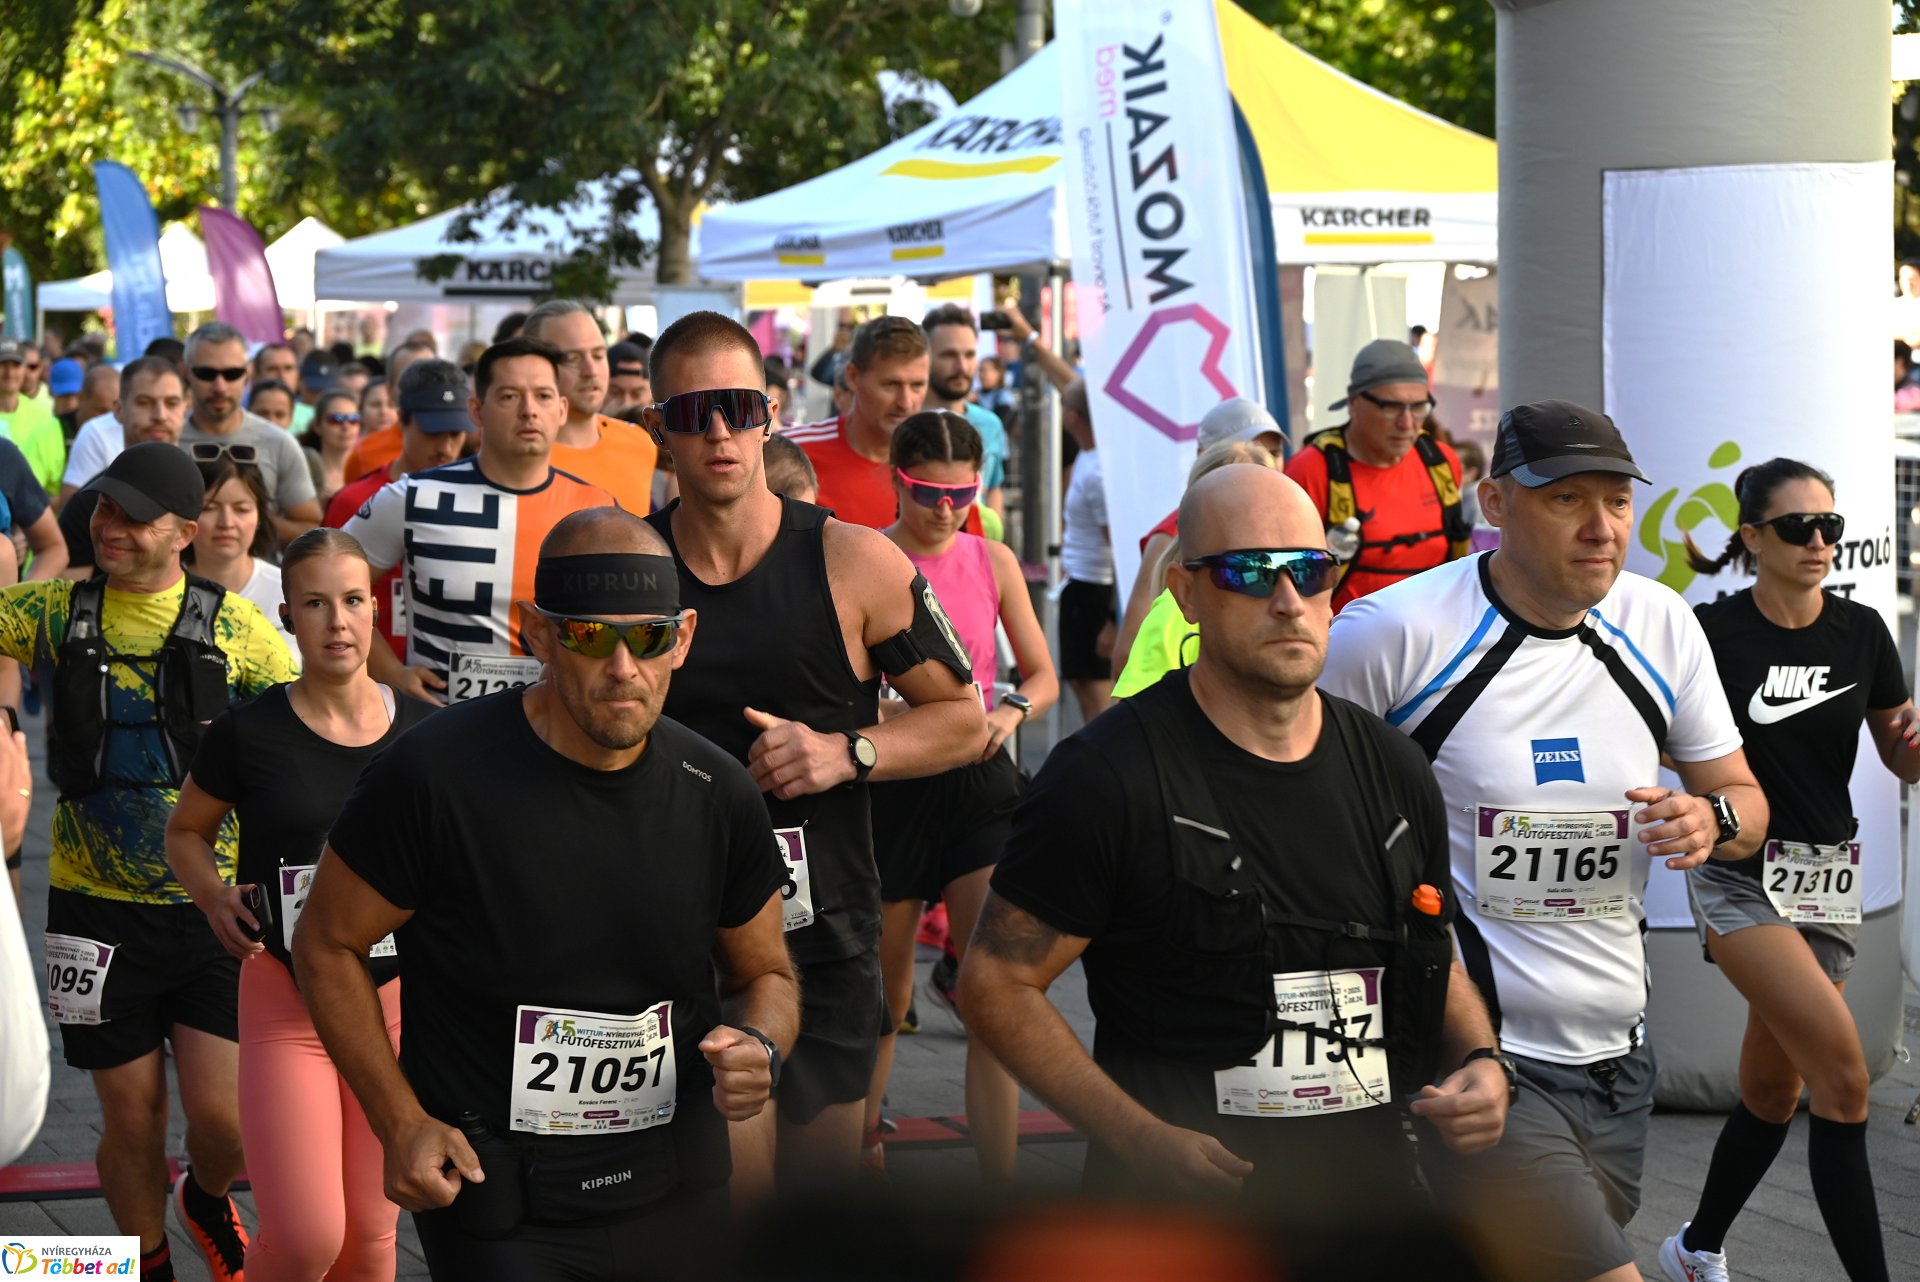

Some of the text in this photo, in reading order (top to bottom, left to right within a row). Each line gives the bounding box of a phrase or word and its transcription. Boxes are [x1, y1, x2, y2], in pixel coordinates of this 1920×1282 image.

[562, 571, 658, 593] KIPRUN
[1763, 665, 1831, 699] NIKE
[1534, 750, 1580, 764] ZEISS
[682, 759, 713, 783] DOMYOS
[1517, 828, 1594, 839] FUTÓFESZTIVÁL
[1489, 844, 1621, 882] 21165
[1769, 867, 1853, 894] 21310
[560, 1035, 645, 1049] FUTÓFESZTIVÁL
[1250, 1013, 1373, 1068] 1157
[526, 1045, 666, 1093] 21057
[581, 1169, 632, 1190] KIPRUN
